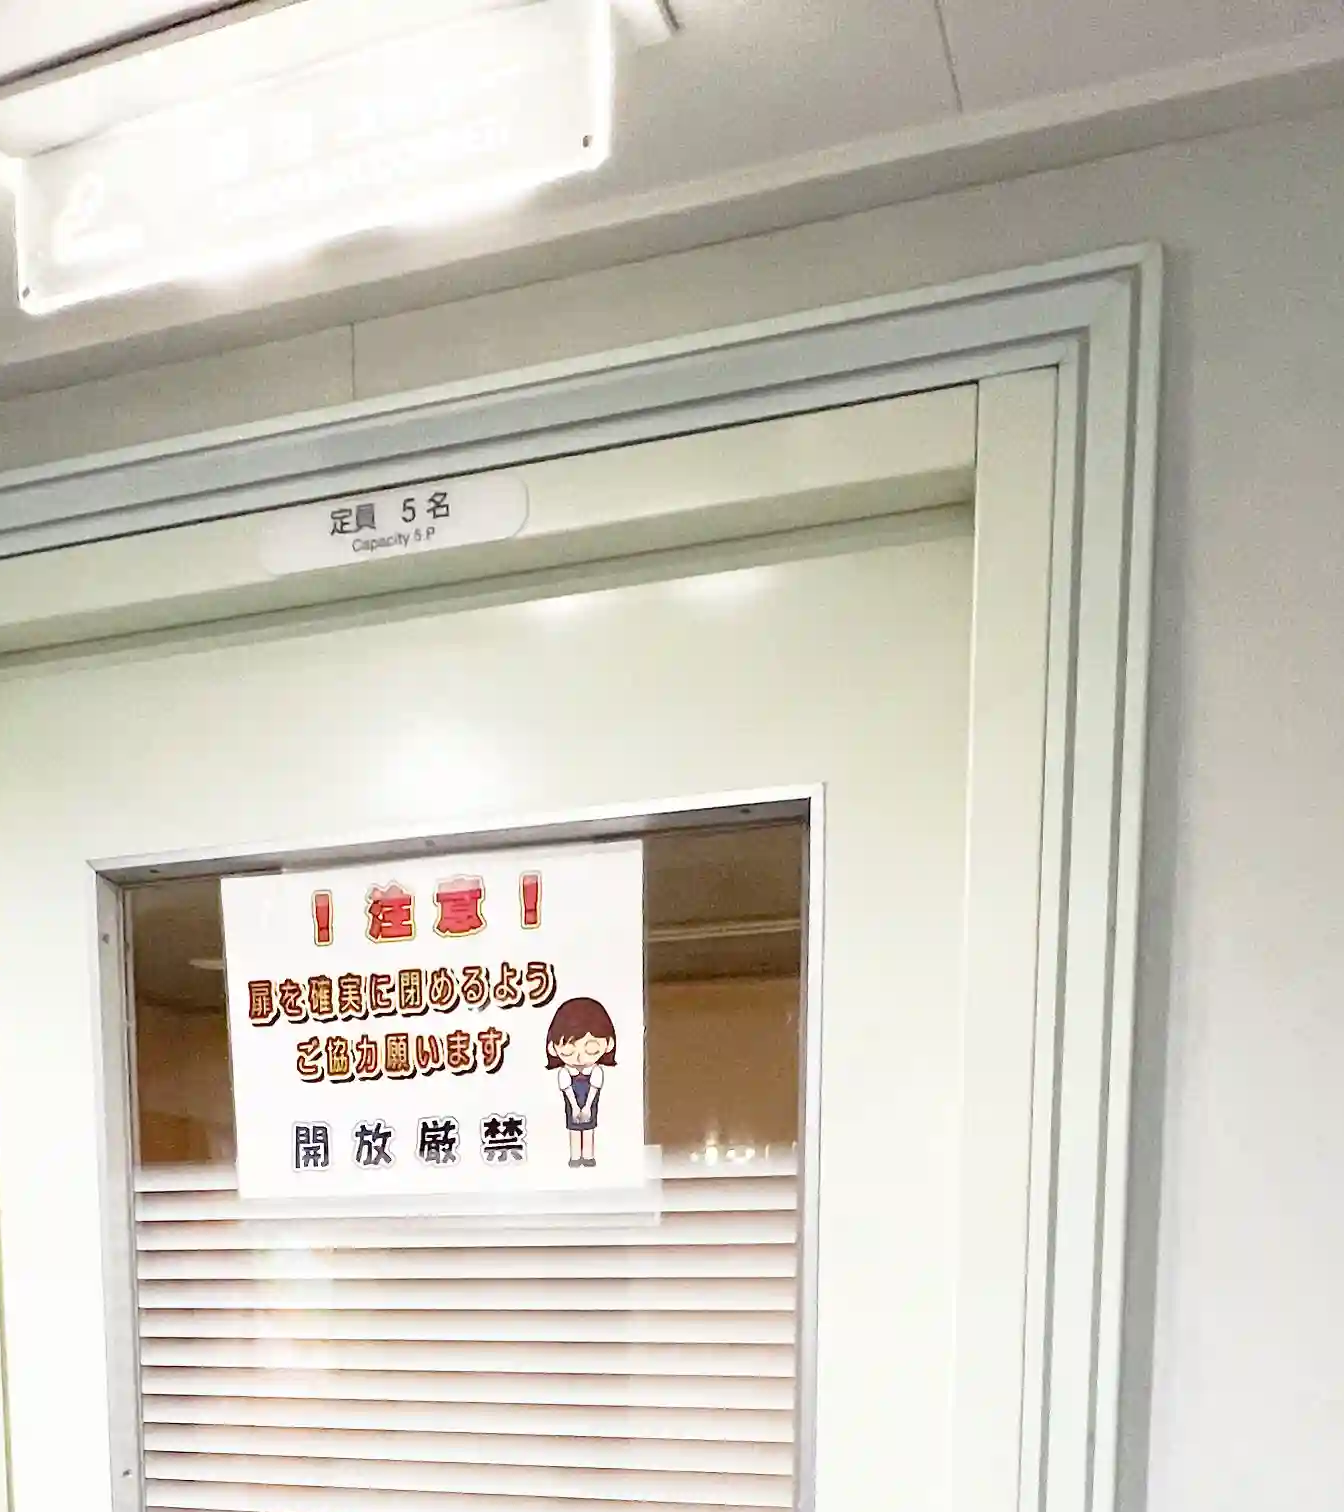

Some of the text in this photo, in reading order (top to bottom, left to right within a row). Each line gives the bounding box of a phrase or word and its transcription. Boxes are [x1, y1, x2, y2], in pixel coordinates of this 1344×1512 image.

[330, 503, 376, 536] 定員
[352, 532, 410, 553] Capacity
[248, 962, 557, 1024] 扉を確実に閉めるよう
[297, 1026, 510, 1081] ご協力願います
[294, 1114, 528, 1171] 開放厳禁
